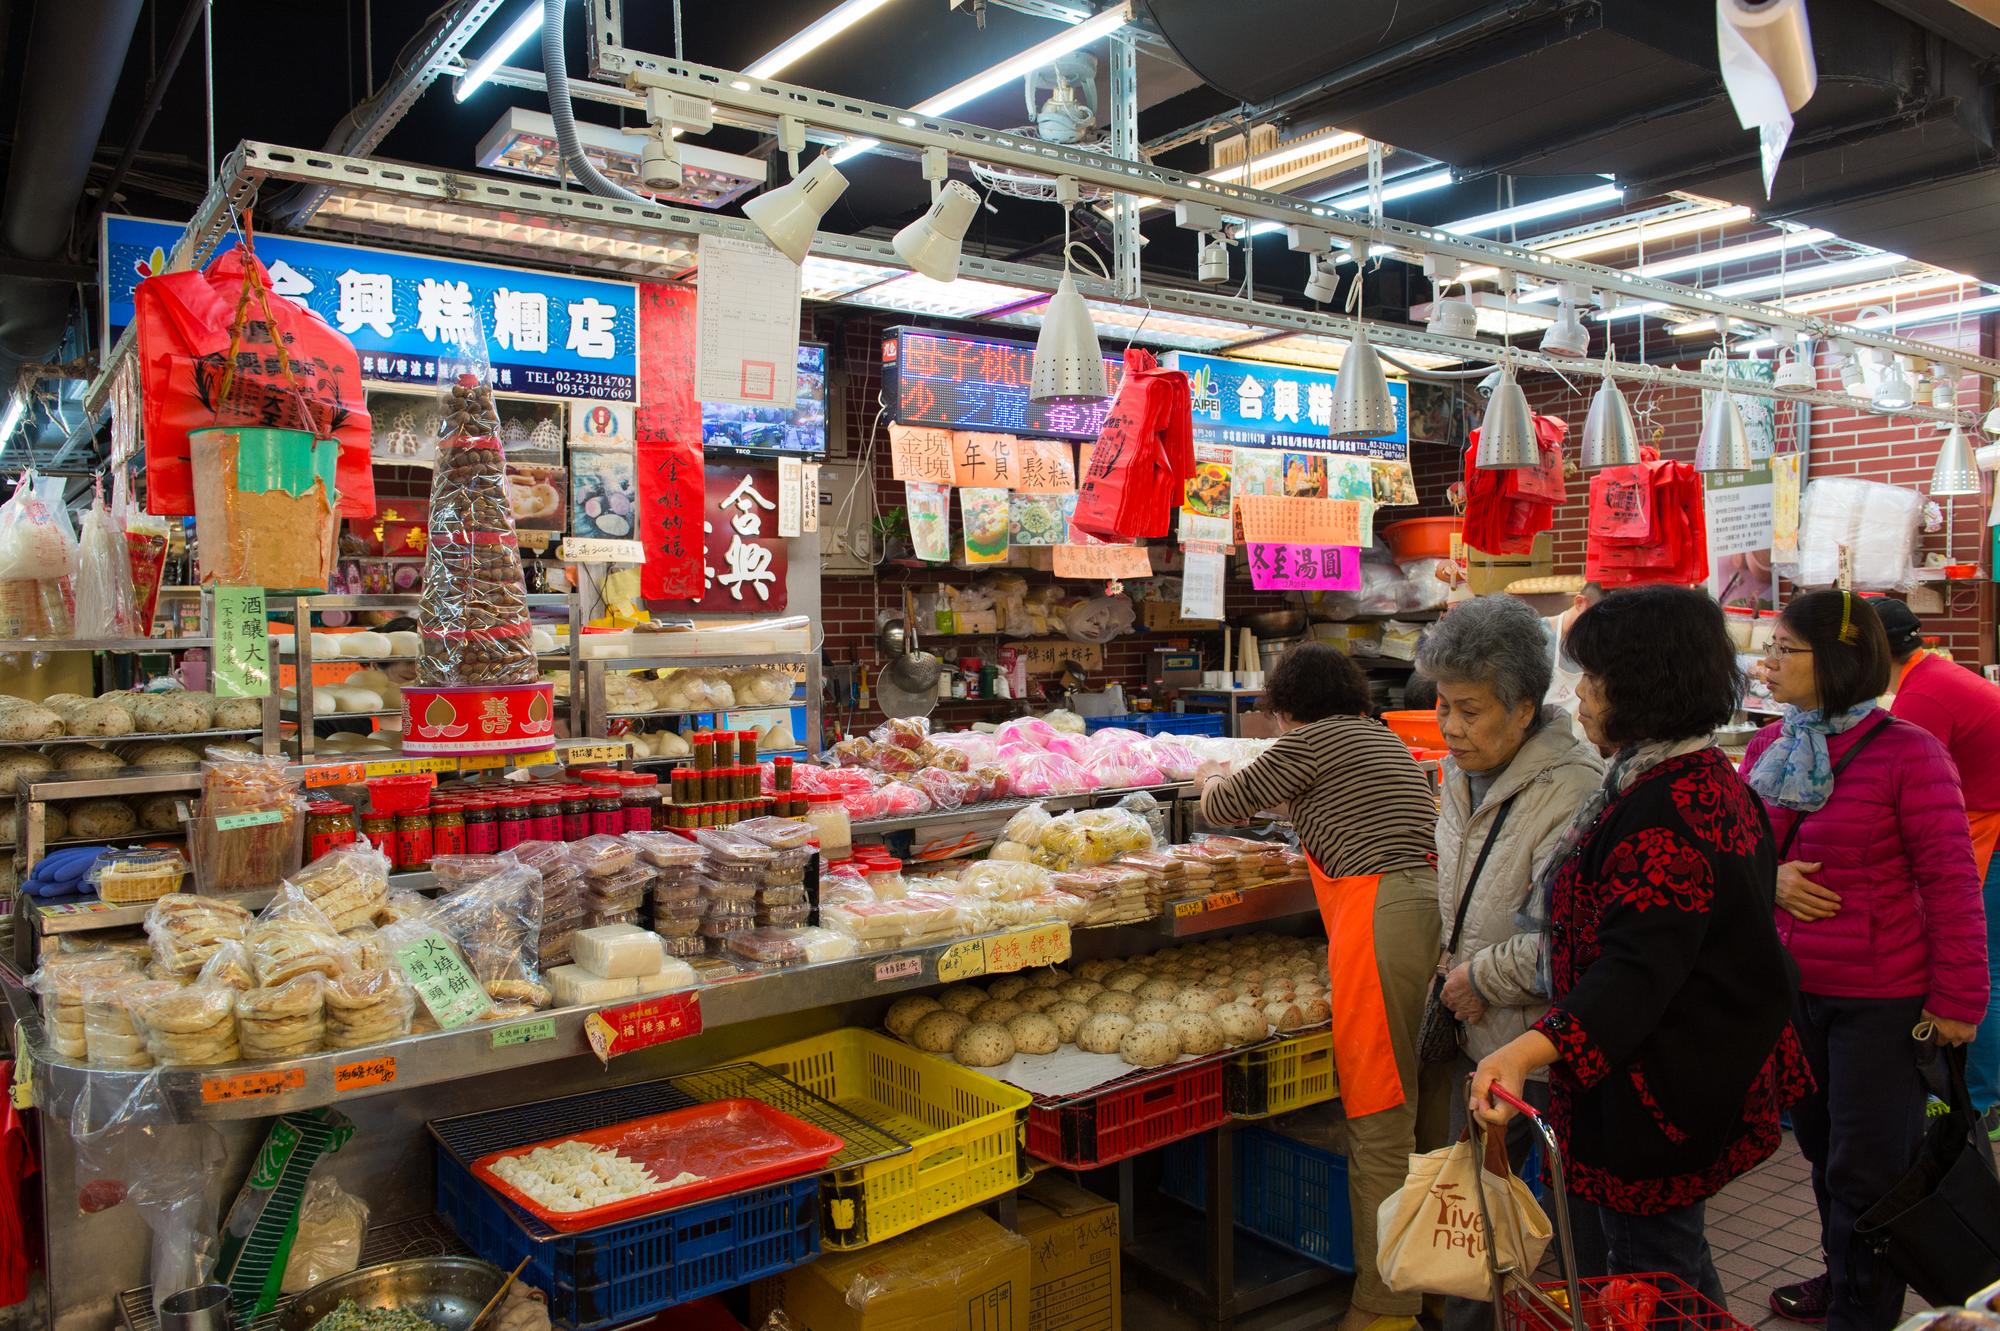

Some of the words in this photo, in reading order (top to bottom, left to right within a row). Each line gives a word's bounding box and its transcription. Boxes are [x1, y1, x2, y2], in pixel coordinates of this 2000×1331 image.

[526, 370, 555, 385] TEL:
[556, 371, 632, 388] 02-23214702
[556, 383, 632, 400] 0935-007669
[897, 429, 950, 456] 金塊
[961, 439, 1011, 481] 年貨
[901, 454, 951, 480] 銀塊
[1023, 457, 1070, 488] 鬆糕
[717, 473, 777, 600] 合興
[1252, 544, 1341, 580] 冬至湯圓
[241, 596, 265, 687] 酒釀大餅
[478, 696, 513, 734] 壽
[423, 938, 471, 994] 火燒餅
